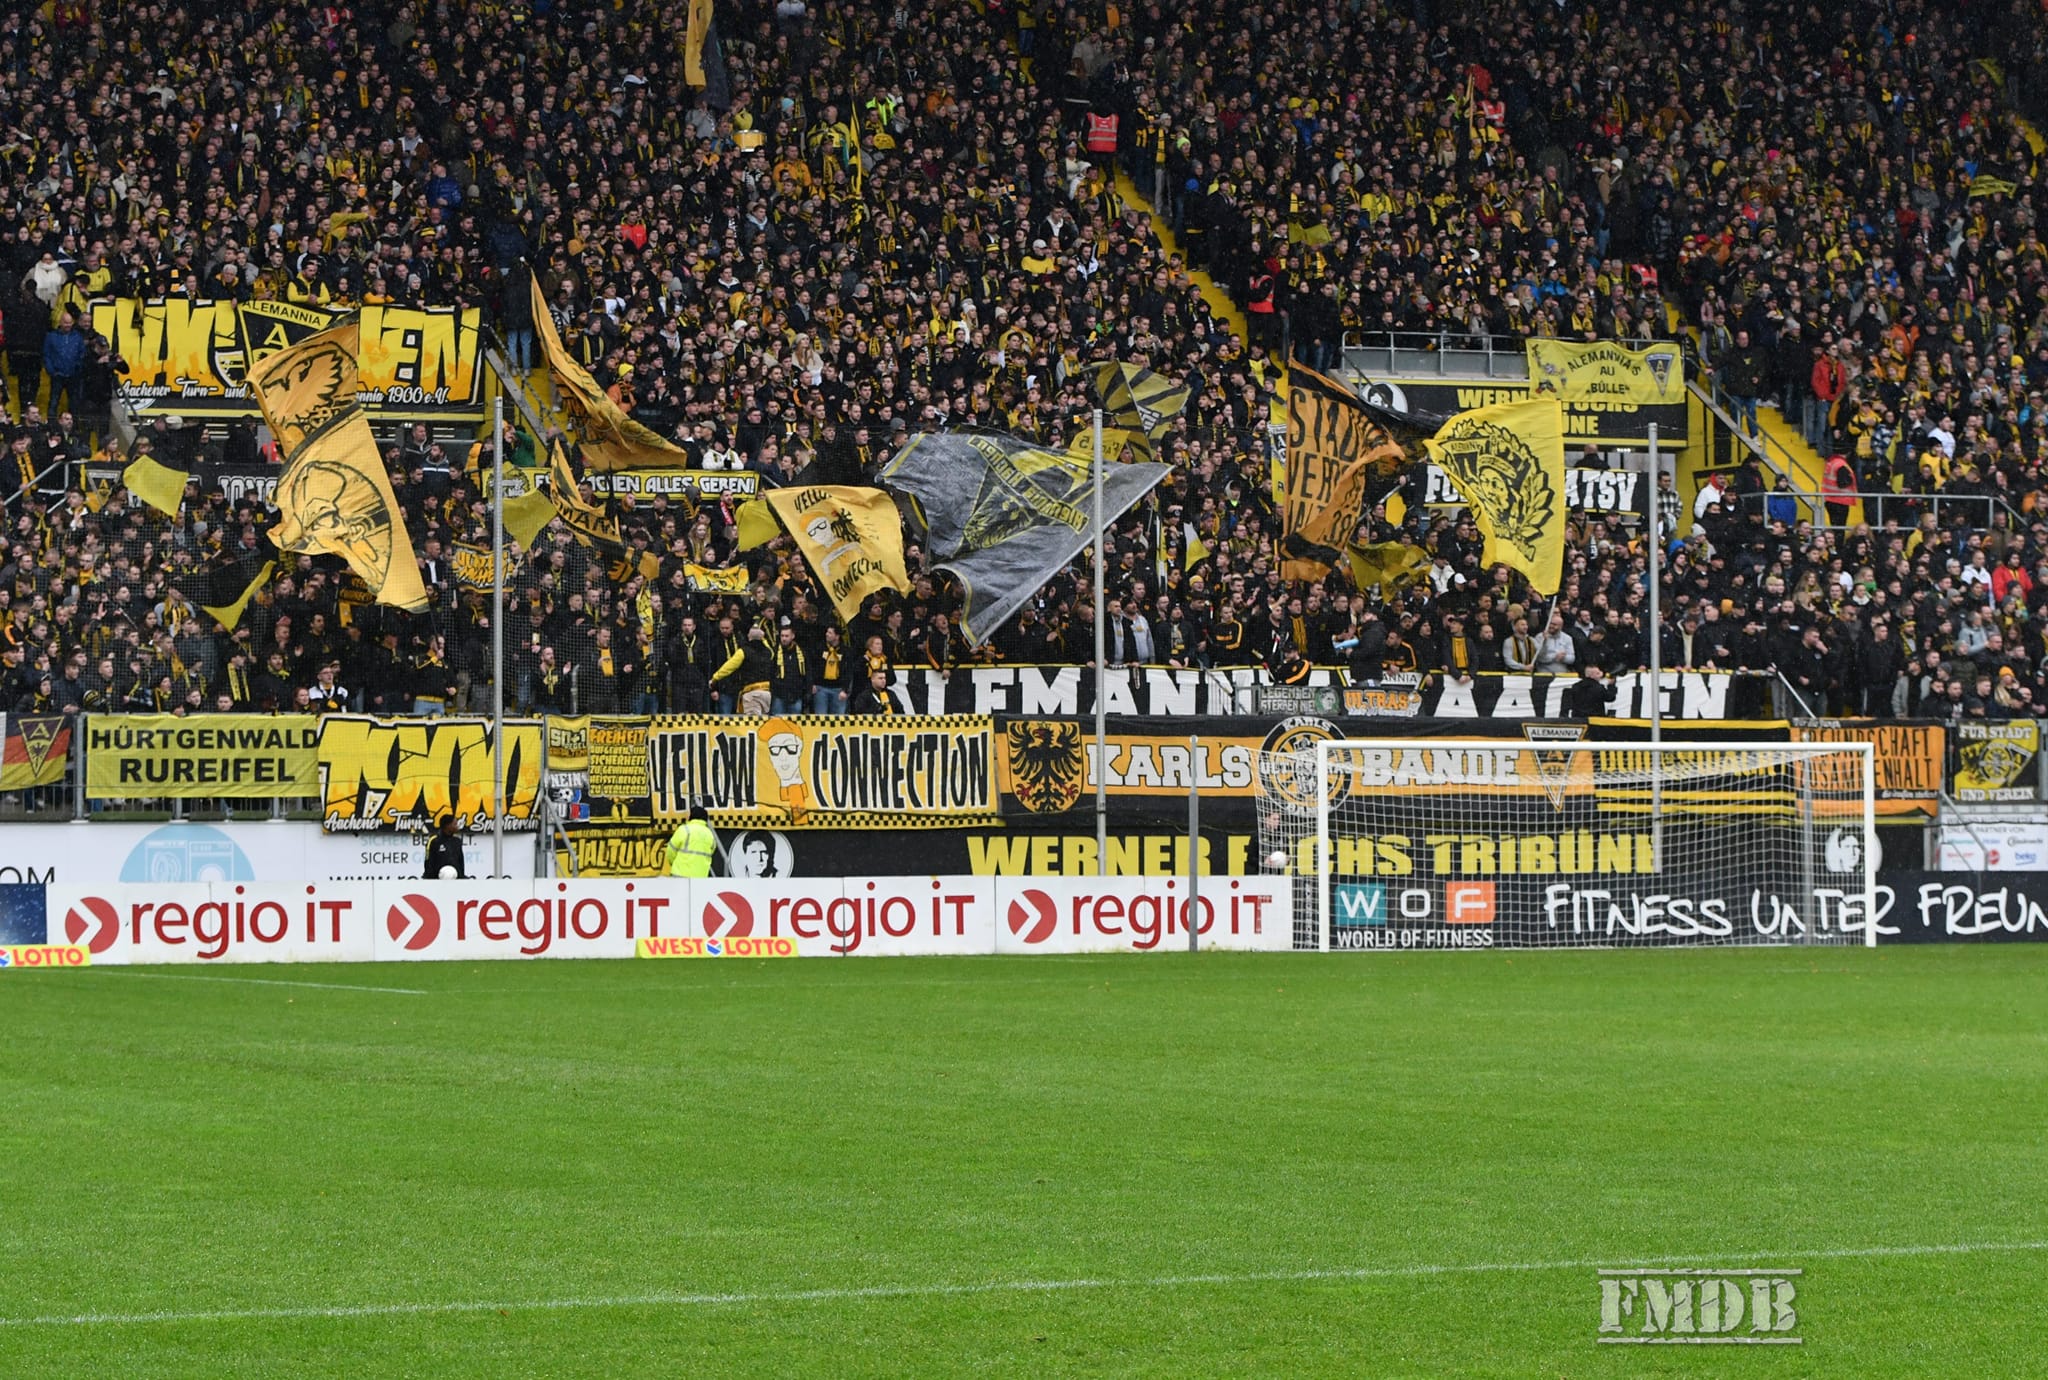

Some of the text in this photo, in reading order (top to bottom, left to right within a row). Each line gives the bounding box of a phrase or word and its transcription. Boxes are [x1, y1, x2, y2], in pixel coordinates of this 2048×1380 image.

[242, 299, 321, 326] ALEMANNIA
[1600, 366, 1616, 376] AU
[176, 377, 218, 400] Turn-
[645, 476, 692, 494] ALLES
[700, 477, 756, 494] GEBEN!
[1343, 690, 1409, 712] ULTRAS
[91, 725, 319, 750] HÜRTGENWALD
[589, 729, 646, 744] FREIHEIT
[1531, 728, 1579, 738] ALEMANNIA
[1959, 724, 2033, 740] FÜR STADT
[119, 758, 296, 783] RUREIFEL
[590, 754, 646, 766] SICHERHEIT
[650, 731, 989, 812] YELLOW CONNECTION
[1087, 744, 1251, 788] KARLS
[1361, 749, 1520, 786] BANDE
[1960, 788, 2035, 801] UND VEREIN
[324, 815, 384, 832] Aachener
[361, 851, 408, 865] SICHER
[569, 838, 667, 872] HALTUNG
[967, 835, 1211, 877] WERNER
[1227, 834, 1413, 876] FCHS
[132, 884, 352, 959] regio iT
[457, 883, 670, 955] regio iT
[770, 880, 975, 952] regio iT
[1072, 880, 1215, 949] regio
[1230, 880, 1273, 935] iT
[1544, 884, 1733, 937] FITNESS
[1751, 886, 1901, 936] UNTER
[644, 938, 793, 956] WEST LOTTO
[1336, 929, 1493, 948] WORLD OF FITNESS
[13, 948, 84, 967] LOTTO
